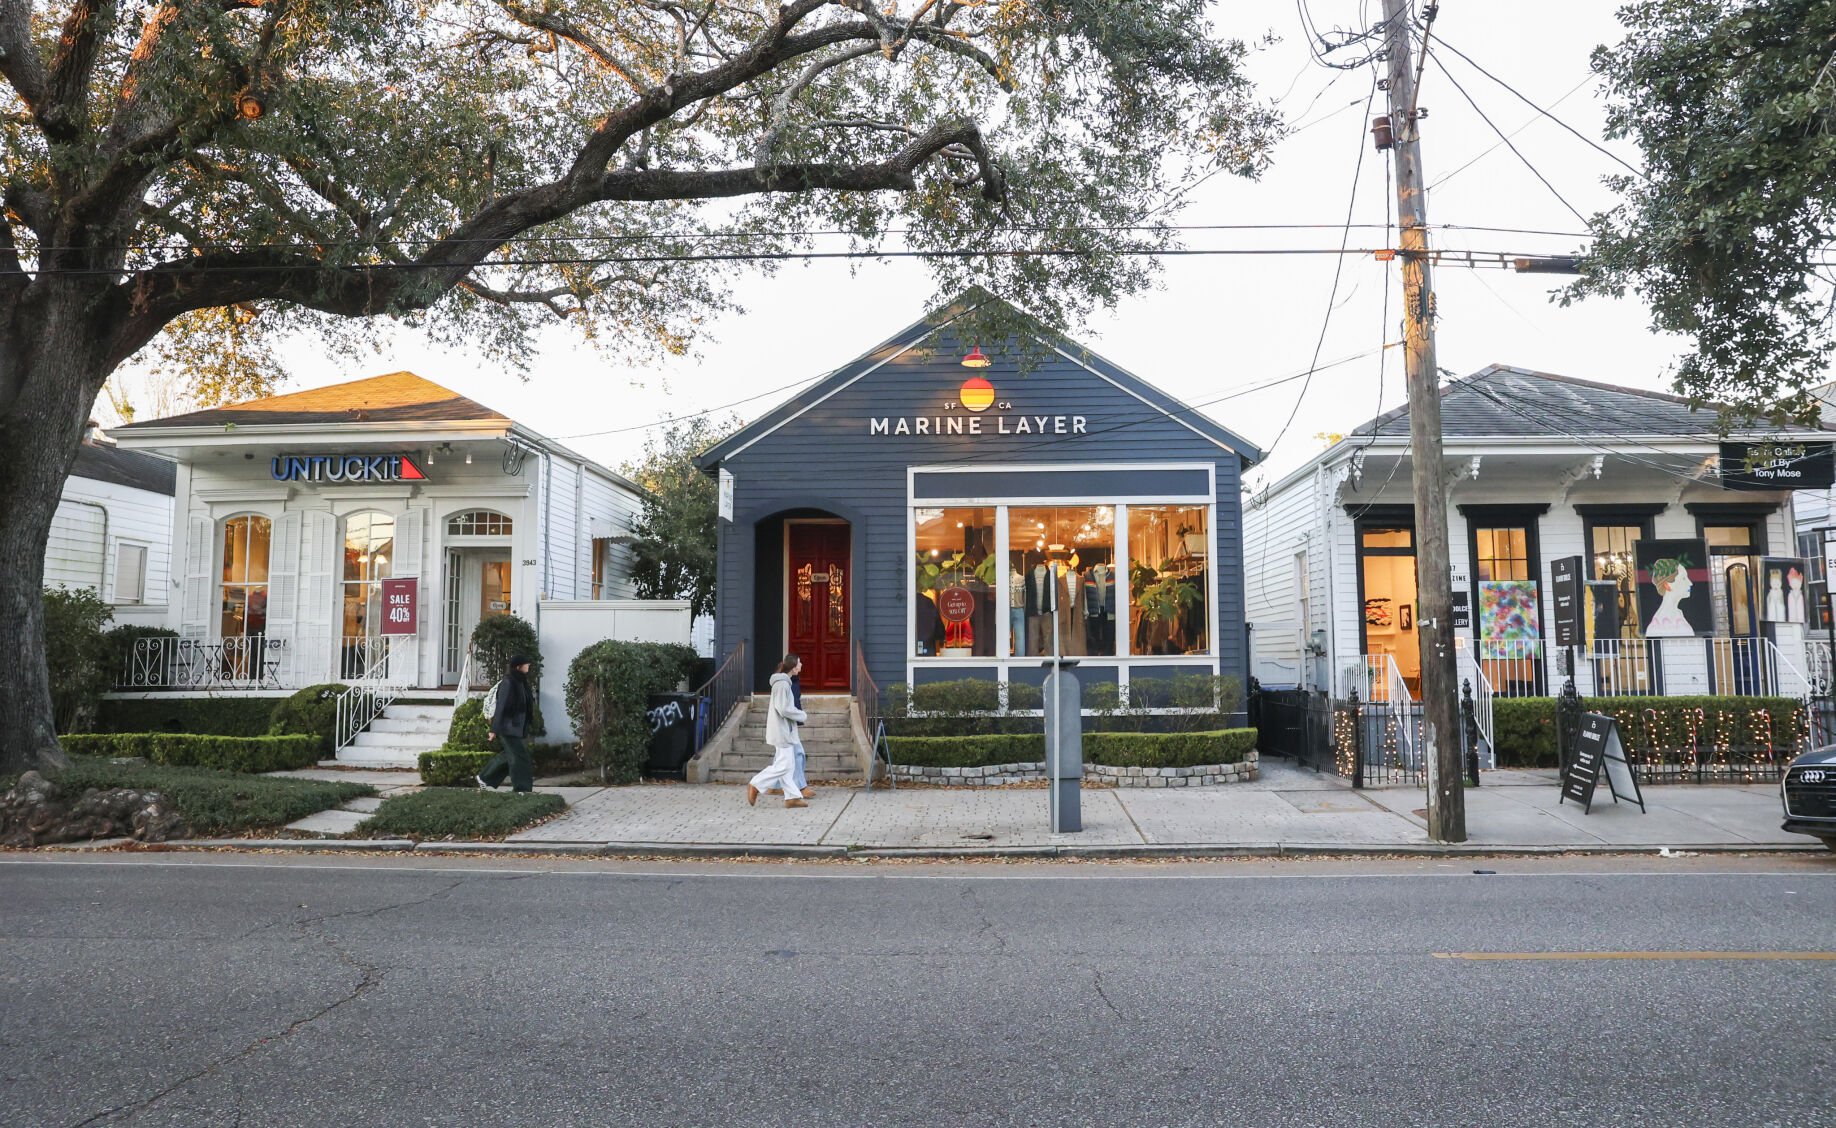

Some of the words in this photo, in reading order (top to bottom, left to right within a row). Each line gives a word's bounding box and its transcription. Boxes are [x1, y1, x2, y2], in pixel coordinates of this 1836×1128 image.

[944, 402, 957, 410] SF
[870, 416, 982, 435] MARINE
[998, 416, 1088, 434] LAYER
[1778, 458, 1791, 468] By
[1754, 469, 1775, 479] Tony
[1777, 469, 1802, 477] Mose
[390, 594, 410, 604] SALE
[390, 607, 410, 623] 40%
